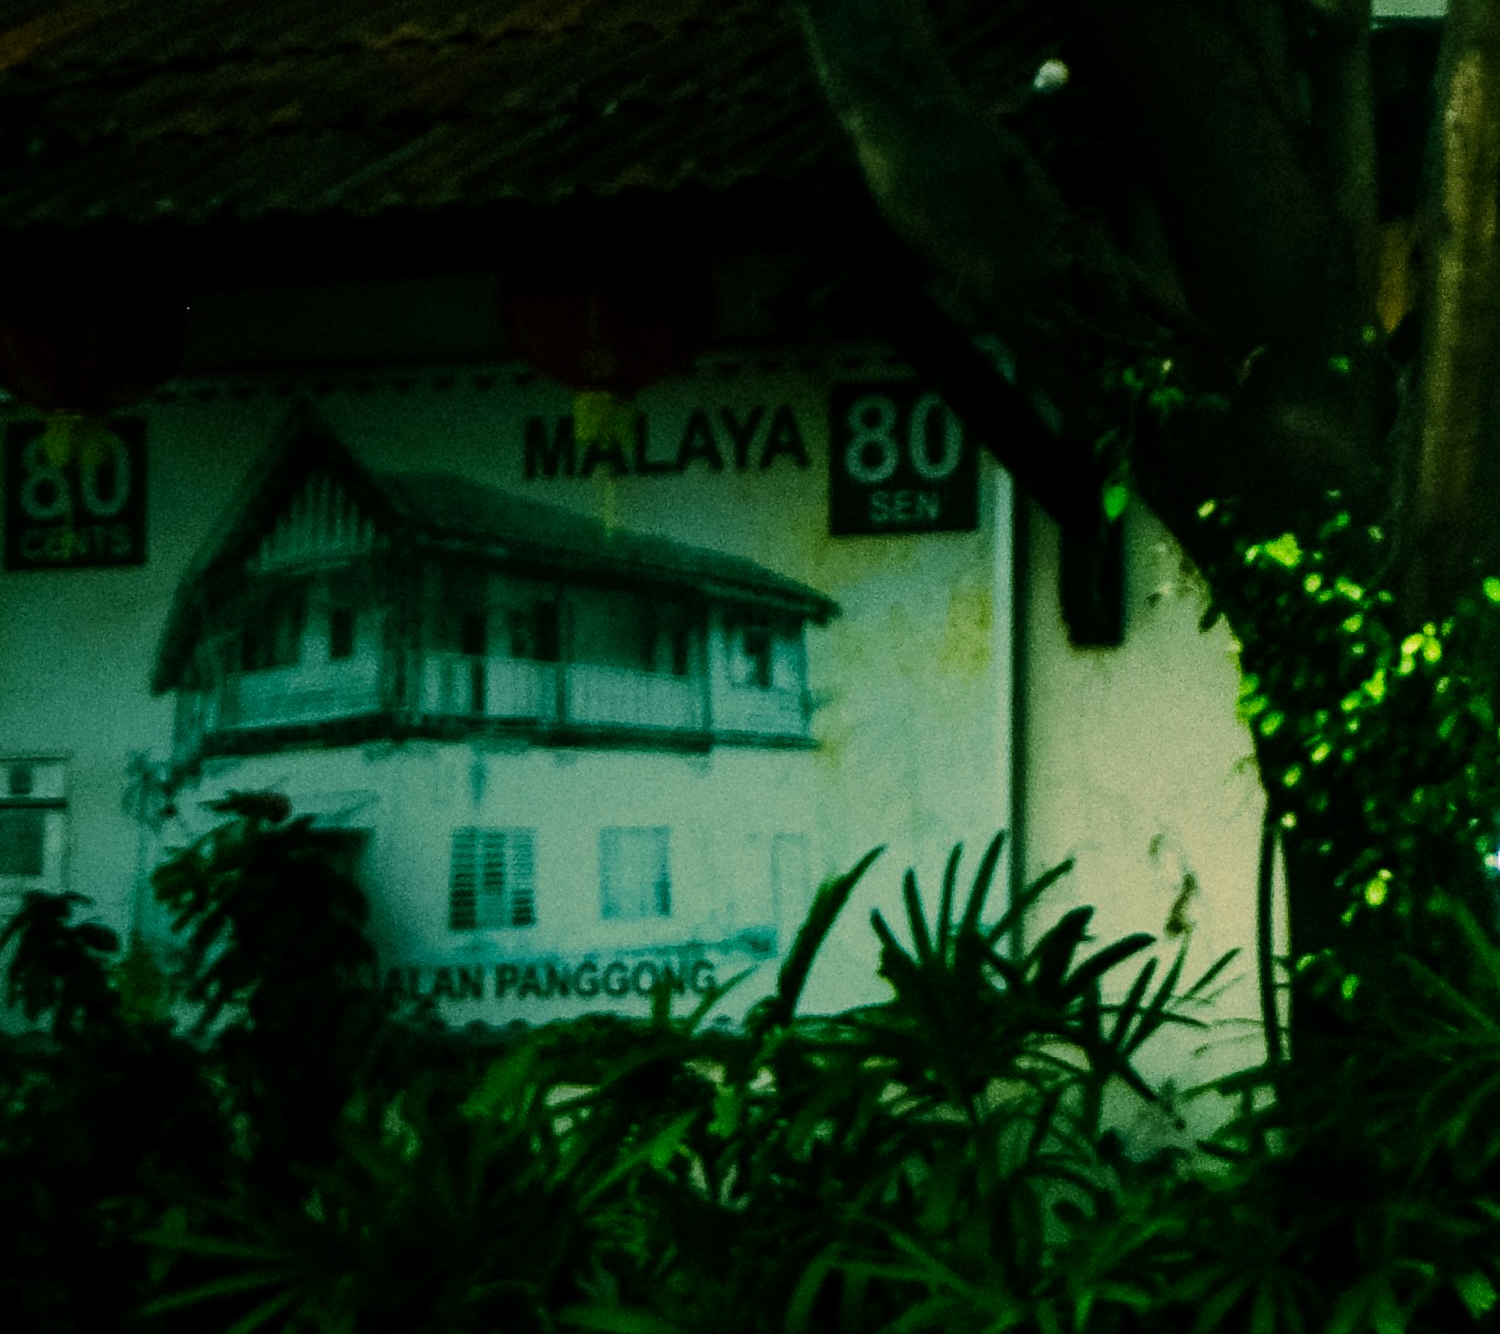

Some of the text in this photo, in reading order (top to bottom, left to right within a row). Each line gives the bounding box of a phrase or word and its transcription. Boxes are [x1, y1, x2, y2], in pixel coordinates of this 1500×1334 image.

[20, 430, 131, 519] 80
[523, 405, 811, 478] MALAYA
[845, 393, 964, 484] 80
[869, 490, 940, 522] SEN
[497, 958, 716, 999] PANGGONG
